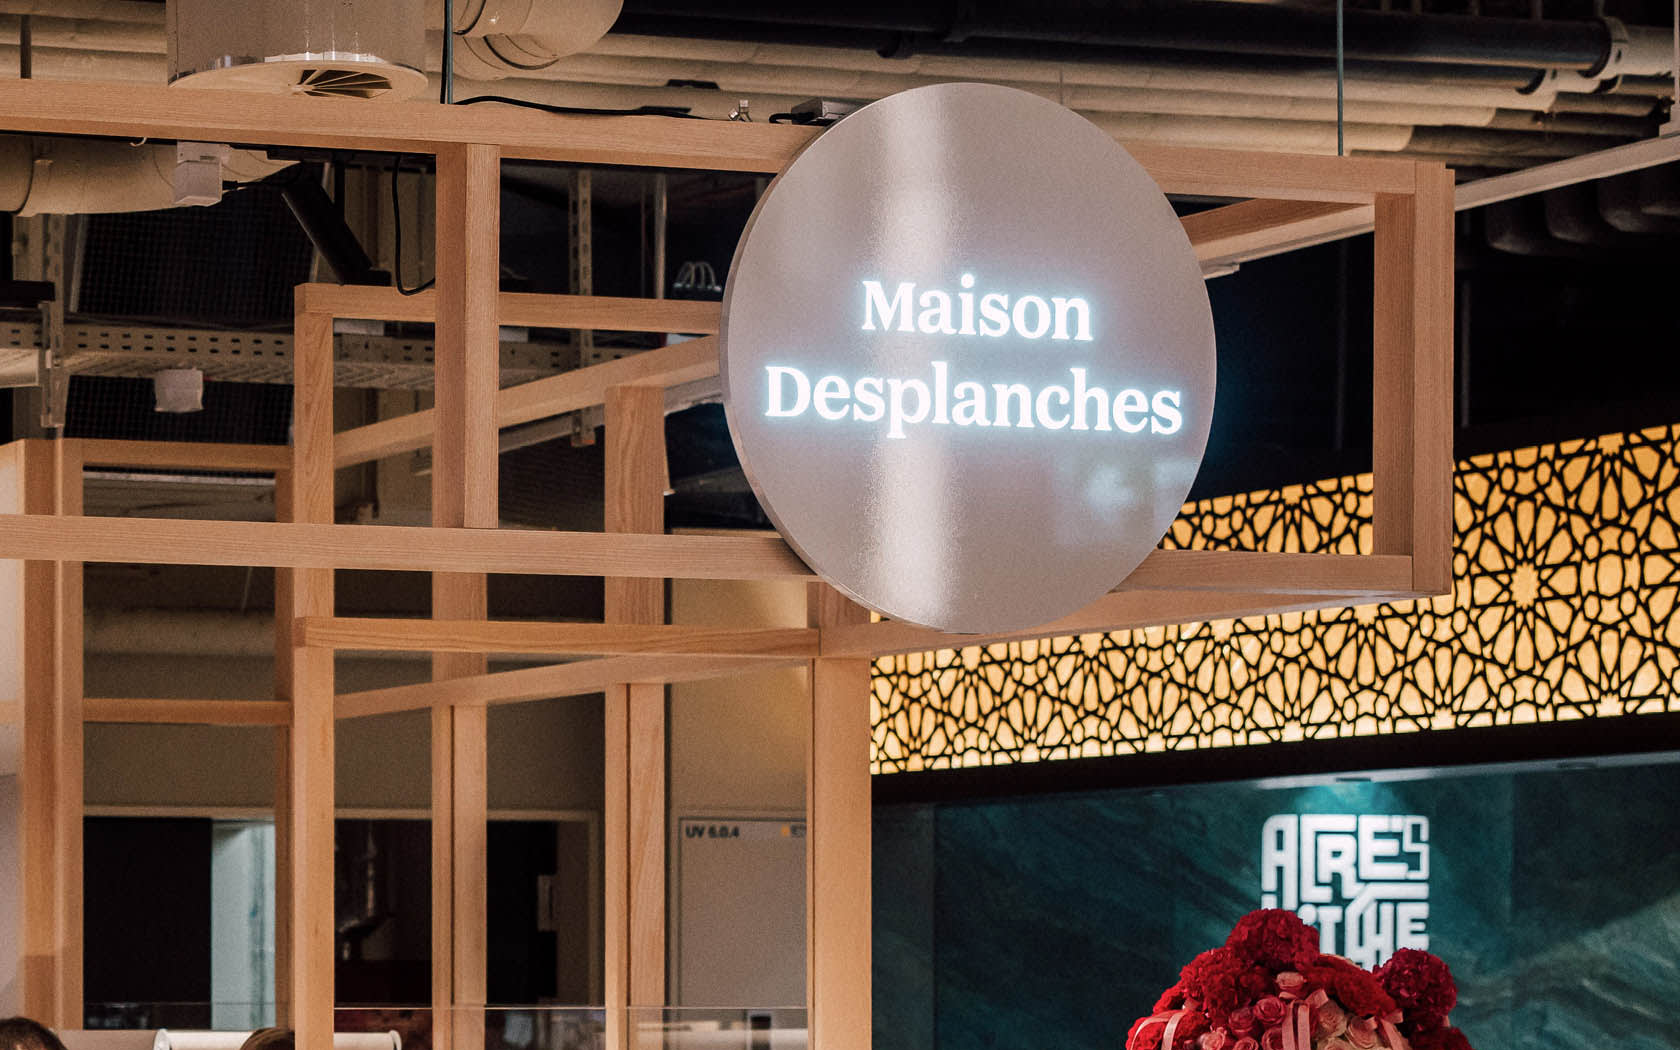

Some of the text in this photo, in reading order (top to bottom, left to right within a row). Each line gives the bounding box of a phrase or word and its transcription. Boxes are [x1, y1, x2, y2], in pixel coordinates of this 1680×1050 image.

[862, 274, 1093, 342] Maison
[764, 361, 1182, 439] Desplanches
[685, 825, 705, 838] UV
